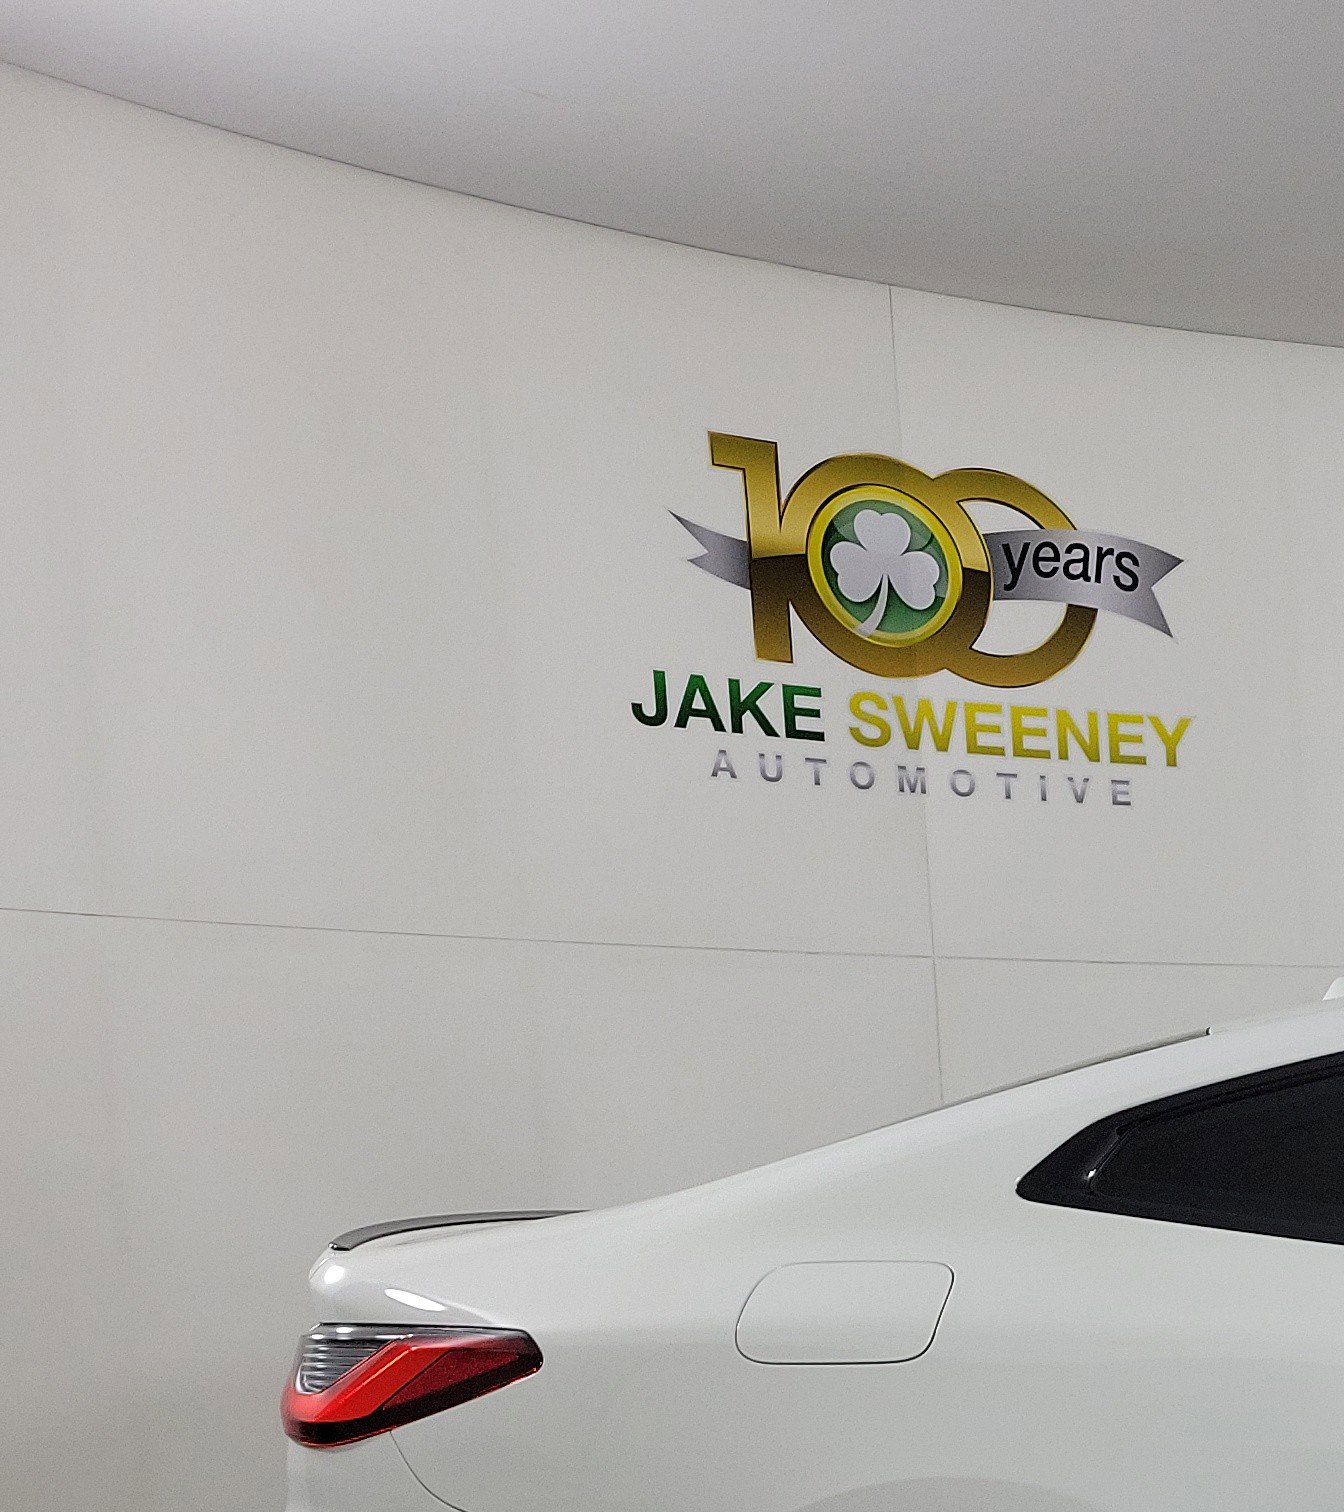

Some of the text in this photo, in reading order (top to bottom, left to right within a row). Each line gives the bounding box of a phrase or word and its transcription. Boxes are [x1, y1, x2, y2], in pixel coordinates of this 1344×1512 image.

[707, 430, 1141, 689] 100 years
[631, 669, 1195, 768] JAKE SWEENEY
[710, 749, 1133, 807] AUTOMOTIVE
